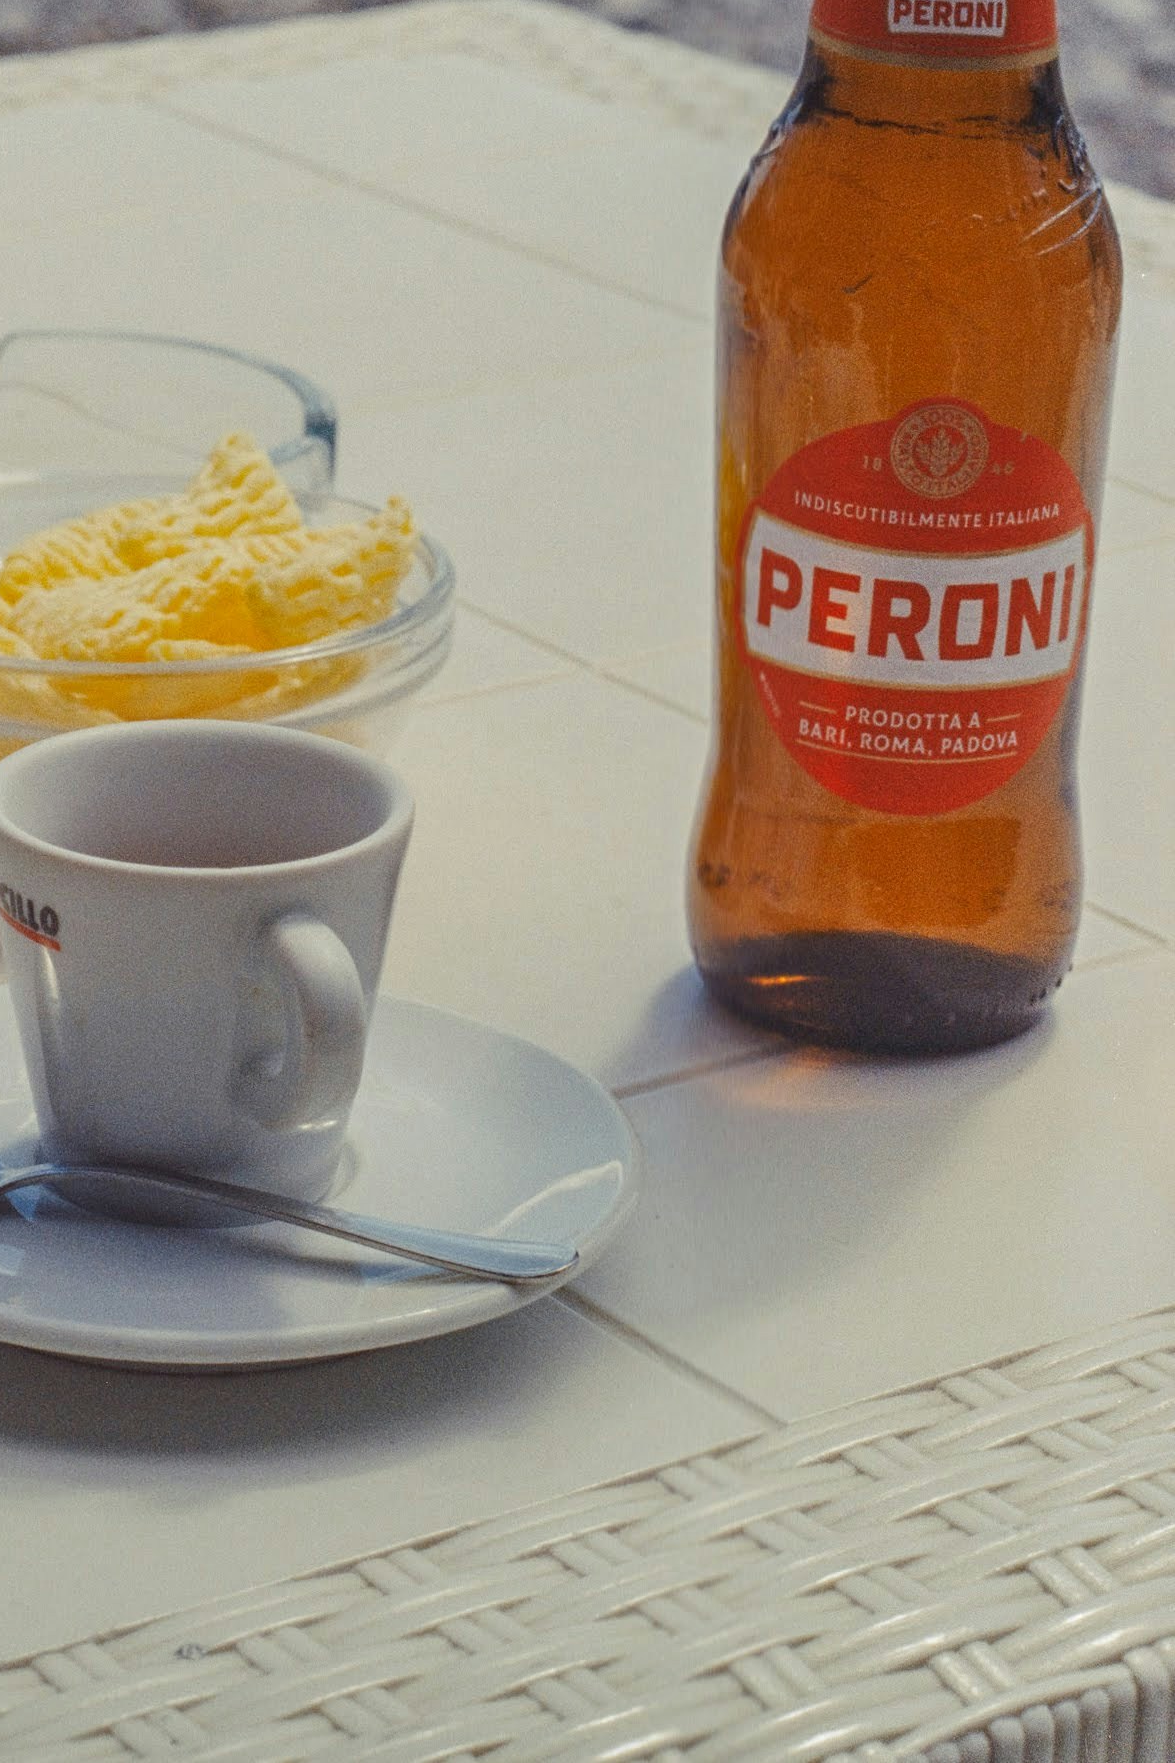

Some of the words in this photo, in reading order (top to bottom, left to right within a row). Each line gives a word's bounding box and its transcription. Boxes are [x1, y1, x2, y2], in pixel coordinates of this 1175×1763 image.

[862, 454, 883, 473] 18
[794, 491, 982, 528] INDISCUTIBILMENTE
[988, 503, 1060, 527] ITALIANA
[756, 546, 1076, 662] PERONI
[845, 705, 962, 731] PRODOTTA
[968, 712, 981, 729] A
[799, 719, 852, 749] BARI,
[860, 731, 933, 757] ROMA,
[940, 730, 1018, 755] PADOVA
